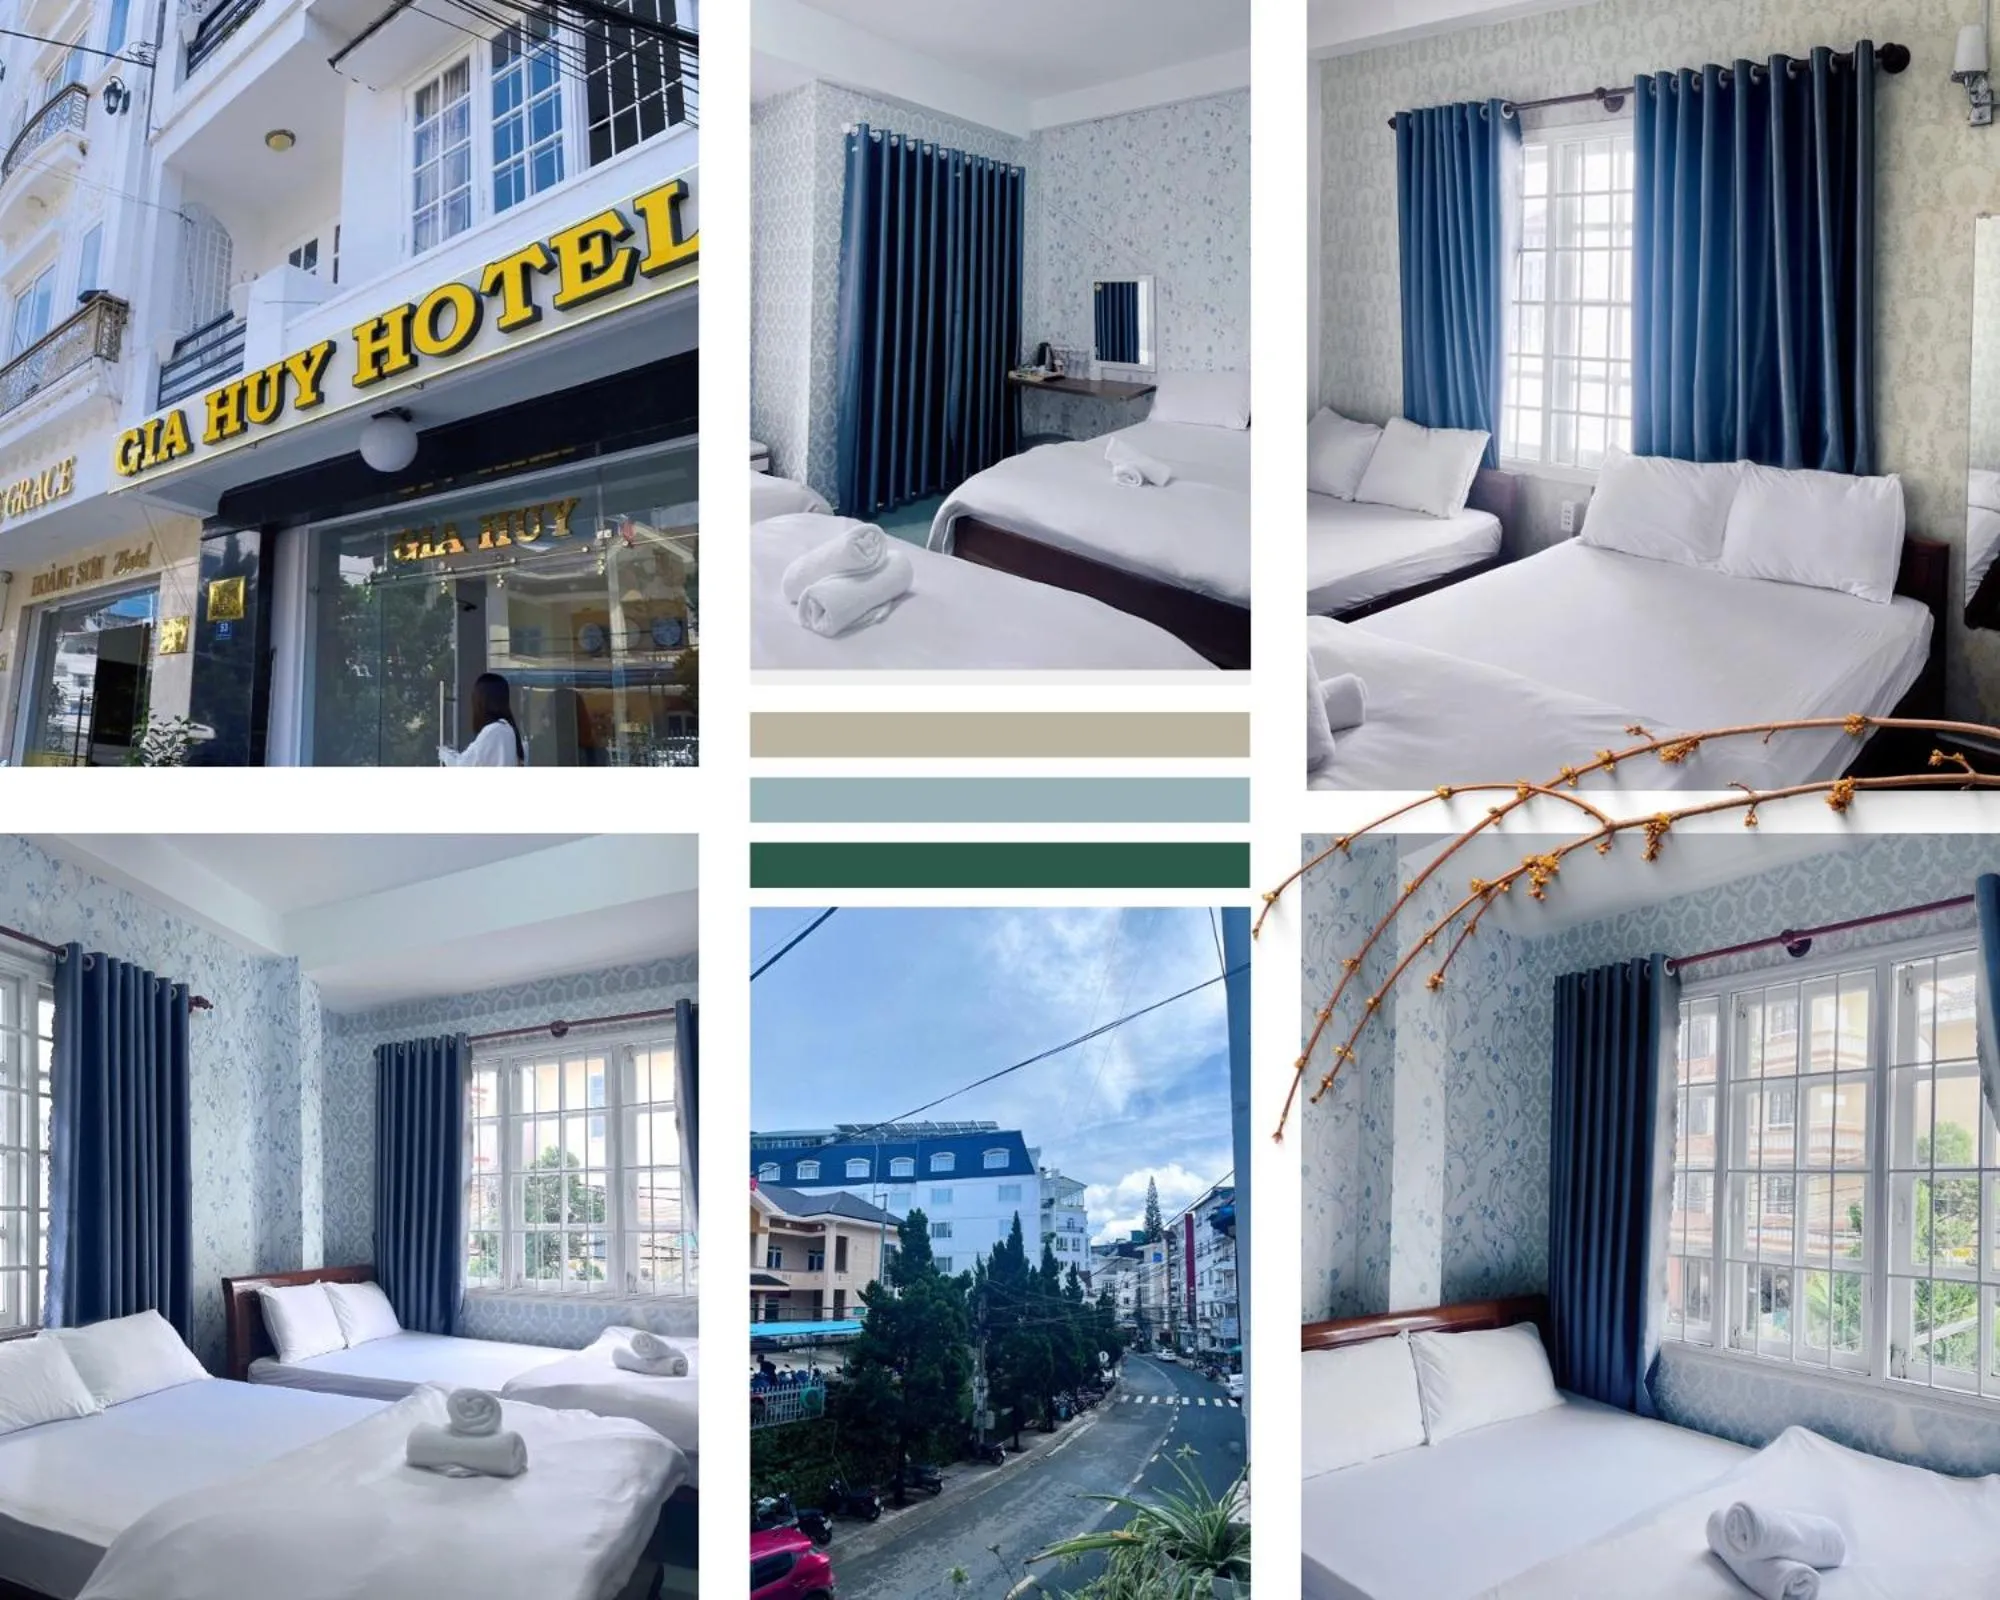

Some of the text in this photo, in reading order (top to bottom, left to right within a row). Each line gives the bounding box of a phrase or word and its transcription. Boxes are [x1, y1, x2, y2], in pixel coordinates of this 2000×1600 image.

[115, 179, 699, 477] GIA HUY HOTEL
[393, 496, 581, 561] GIA HUY
